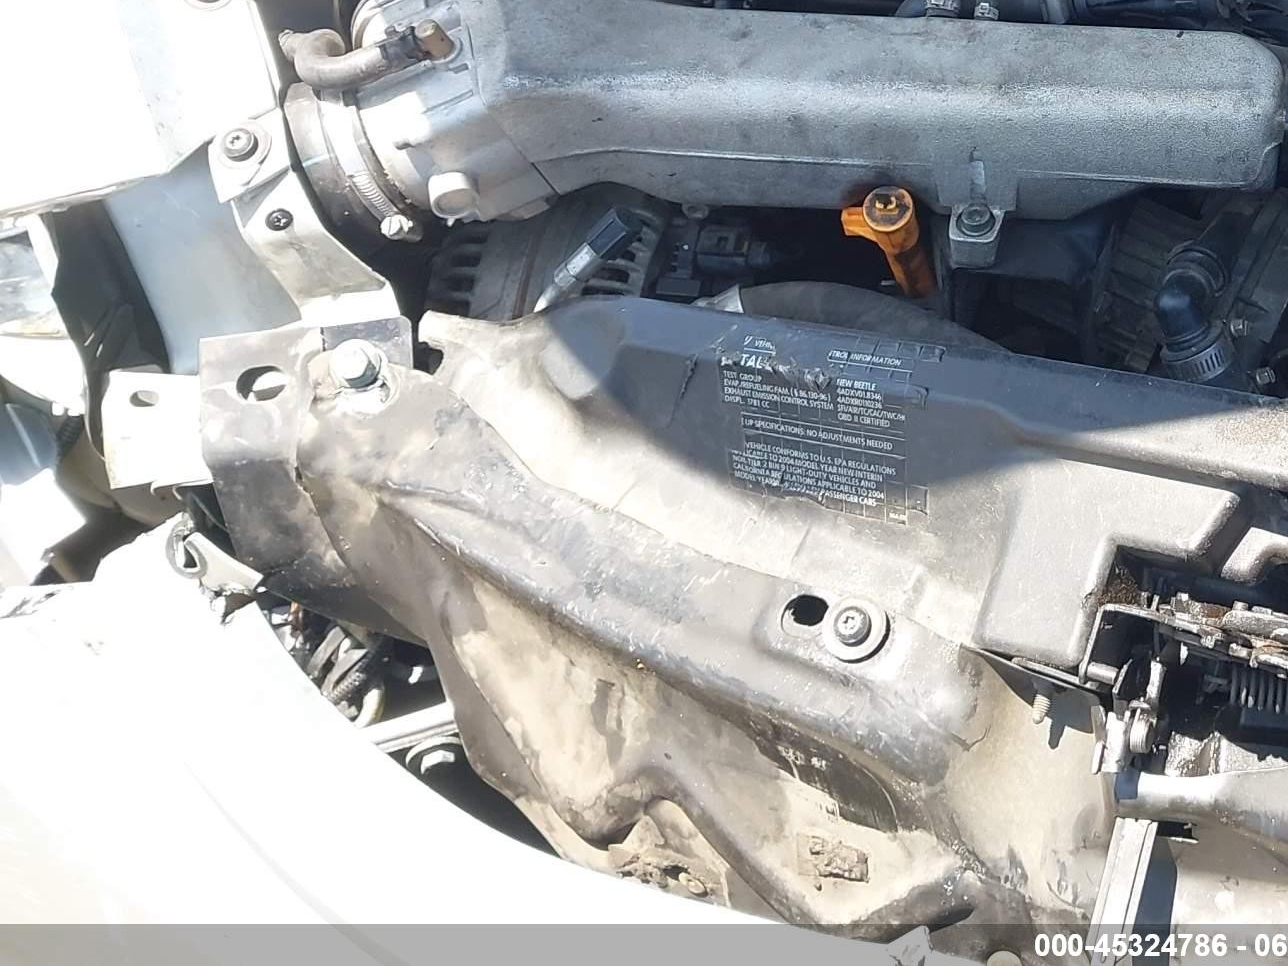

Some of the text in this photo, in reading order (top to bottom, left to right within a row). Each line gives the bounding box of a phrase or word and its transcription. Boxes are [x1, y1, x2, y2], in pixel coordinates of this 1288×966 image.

[850, 353, 902, 366] INFORMATION
[723, 371, 762, 382] TEST GROUP
[837, 378, 878, 391] NEW BEETLE
[724, 387, 834, 410] EXHAUST EMISSION CONTROL SYSTEM
[747, 399, 760, 407] 1781
[837, 413, 852, 422] OBD
[859, 416, 890, 427] CERTIFIED
[806, 429, 817, 437] NO
[818, 431, 866, 446] ADJUSTMENTS
[866, 440, 894, 450] NEEDED
[745, 441, 896, 475] VEHICLE CONFORMS TO U.S. EPA REGULATIONS
[778, 455, 794, 464] 2004
[795, 459, 819, 470] MODEL
[821, 464, 838, 473] YEAR
[839, 468, 855, 477] NEW
[762, 460, 768, 468] 2
[769, 462, 780, 470] BIN
[786, 465, 828, 479] LIGHT-DUTY
[829, 474, 860, 486] VEHICLES
[861, 480, 876, 489] AND
[817, 479, 857, 494] APPLICABLE
[857, 487, 868, 496] TO
[868, 490, 884, 499] 2004
[859, 497, 876, 507] CARS
